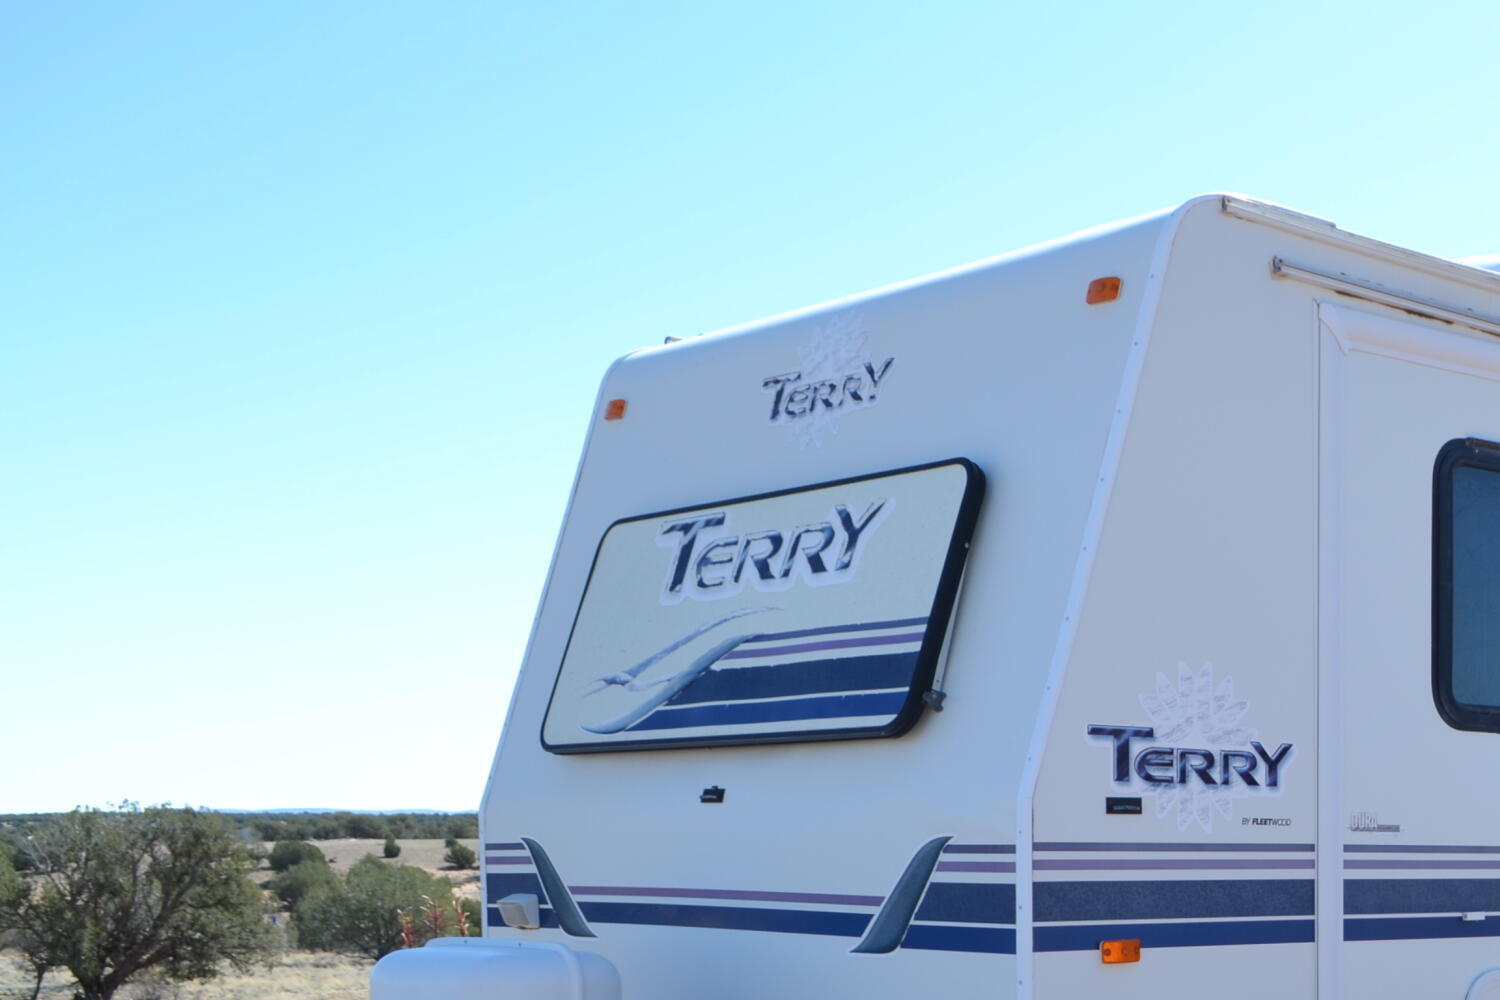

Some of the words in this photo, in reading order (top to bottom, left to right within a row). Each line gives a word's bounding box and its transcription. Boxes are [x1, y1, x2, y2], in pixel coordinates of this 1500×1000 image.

[762, 357, 895, 420] TERRY
[661, 499, 886, 593] TERRY
[1087, 723, 1293, 787] TERRY
[1241, 817, 1250, 825] BY
[1252, 817, 1291, 826] FLEETWOOD
